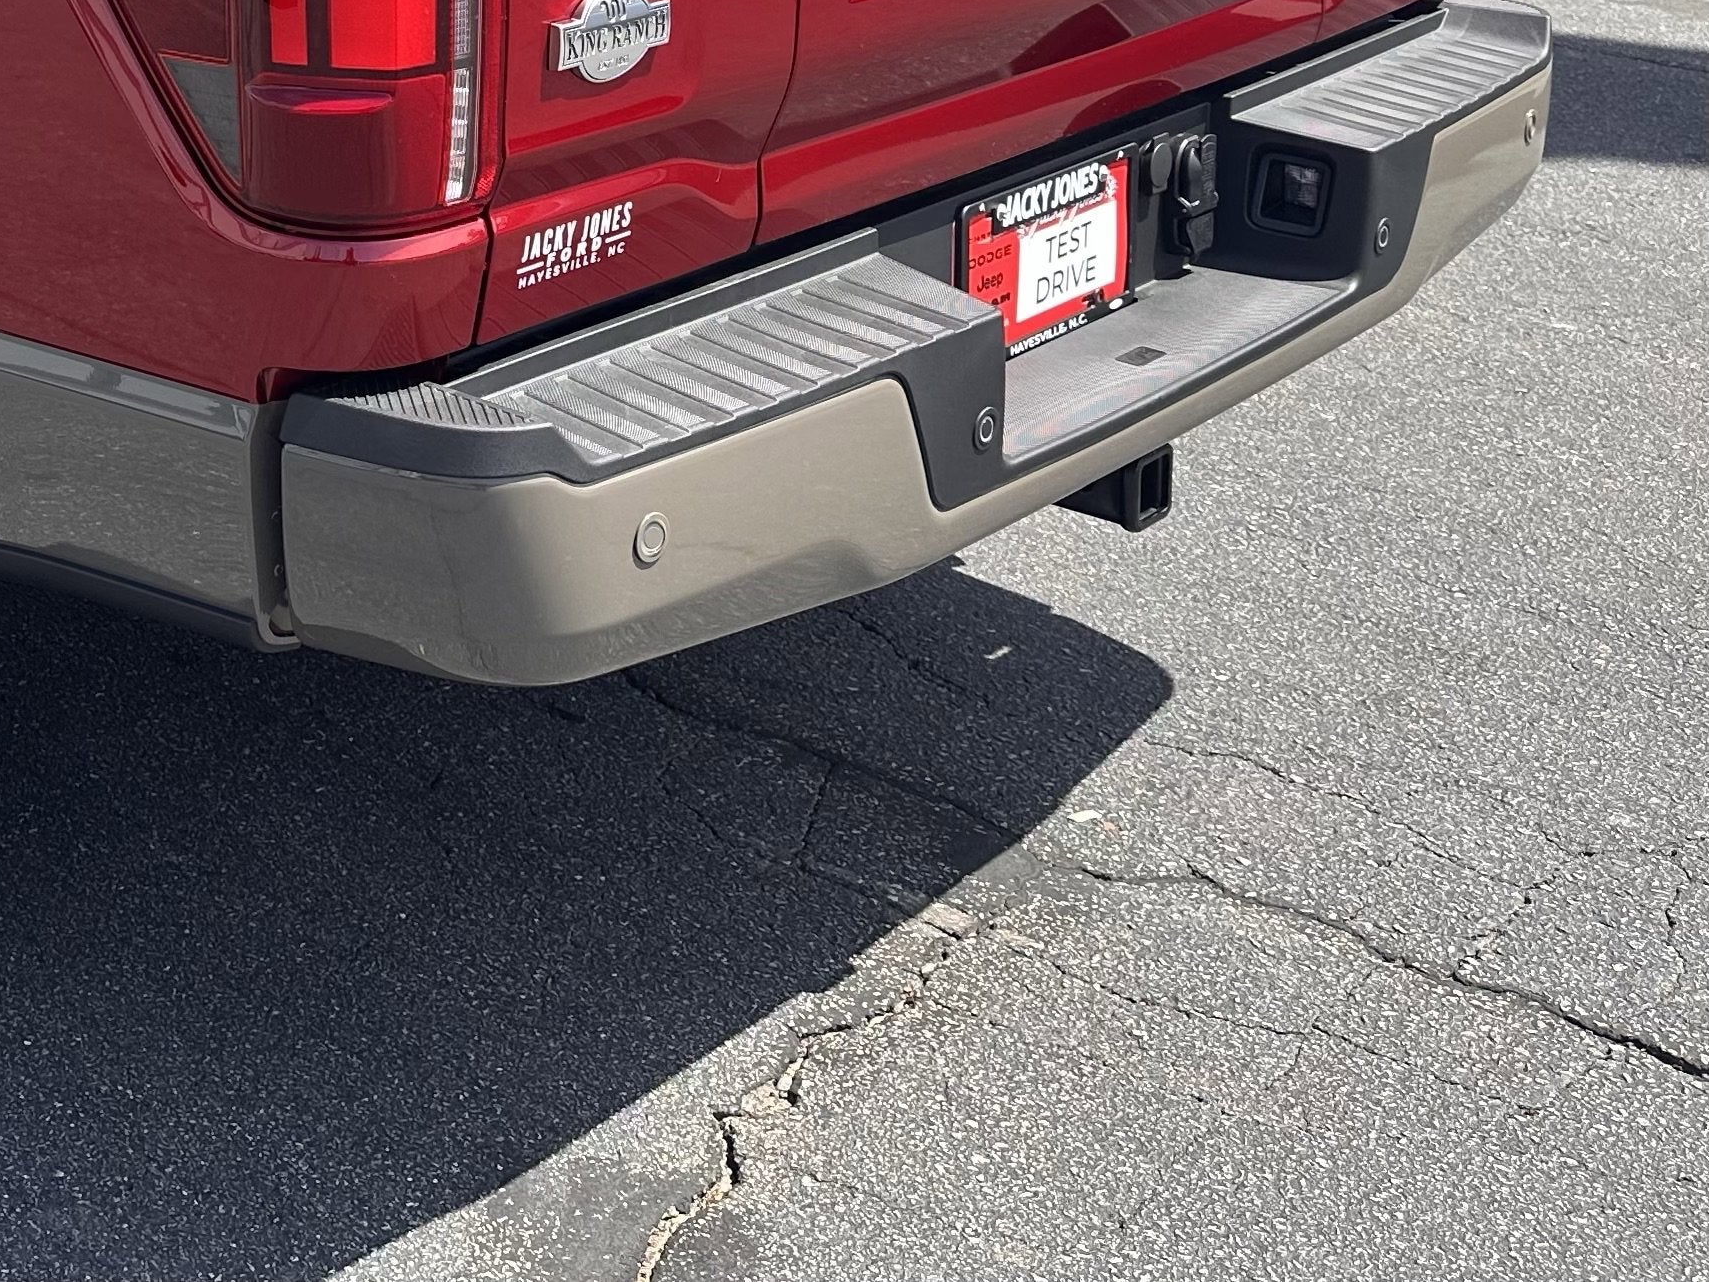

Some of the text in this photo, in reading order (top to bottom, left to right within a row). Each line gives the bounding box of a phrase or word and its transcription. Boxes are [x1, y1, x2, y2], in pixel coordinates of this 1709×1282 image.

[566, 9, 668, 61] KING RANCH
[1001, 178, 1055, 228] JACKY
[1050, 162, 1100, 209] JONES
[521, 201, 634, 264] JACKY JONES
[546, 236, 603, 268] FORD
[607, 241, 627, 258] NC
[1045, 220, 1092, 264] TEST
[968, 244, 1013, 270] DODGE
[976, 271, 1004, 294] Jeep
[1035, 255, 1097, 305] DRIVE
